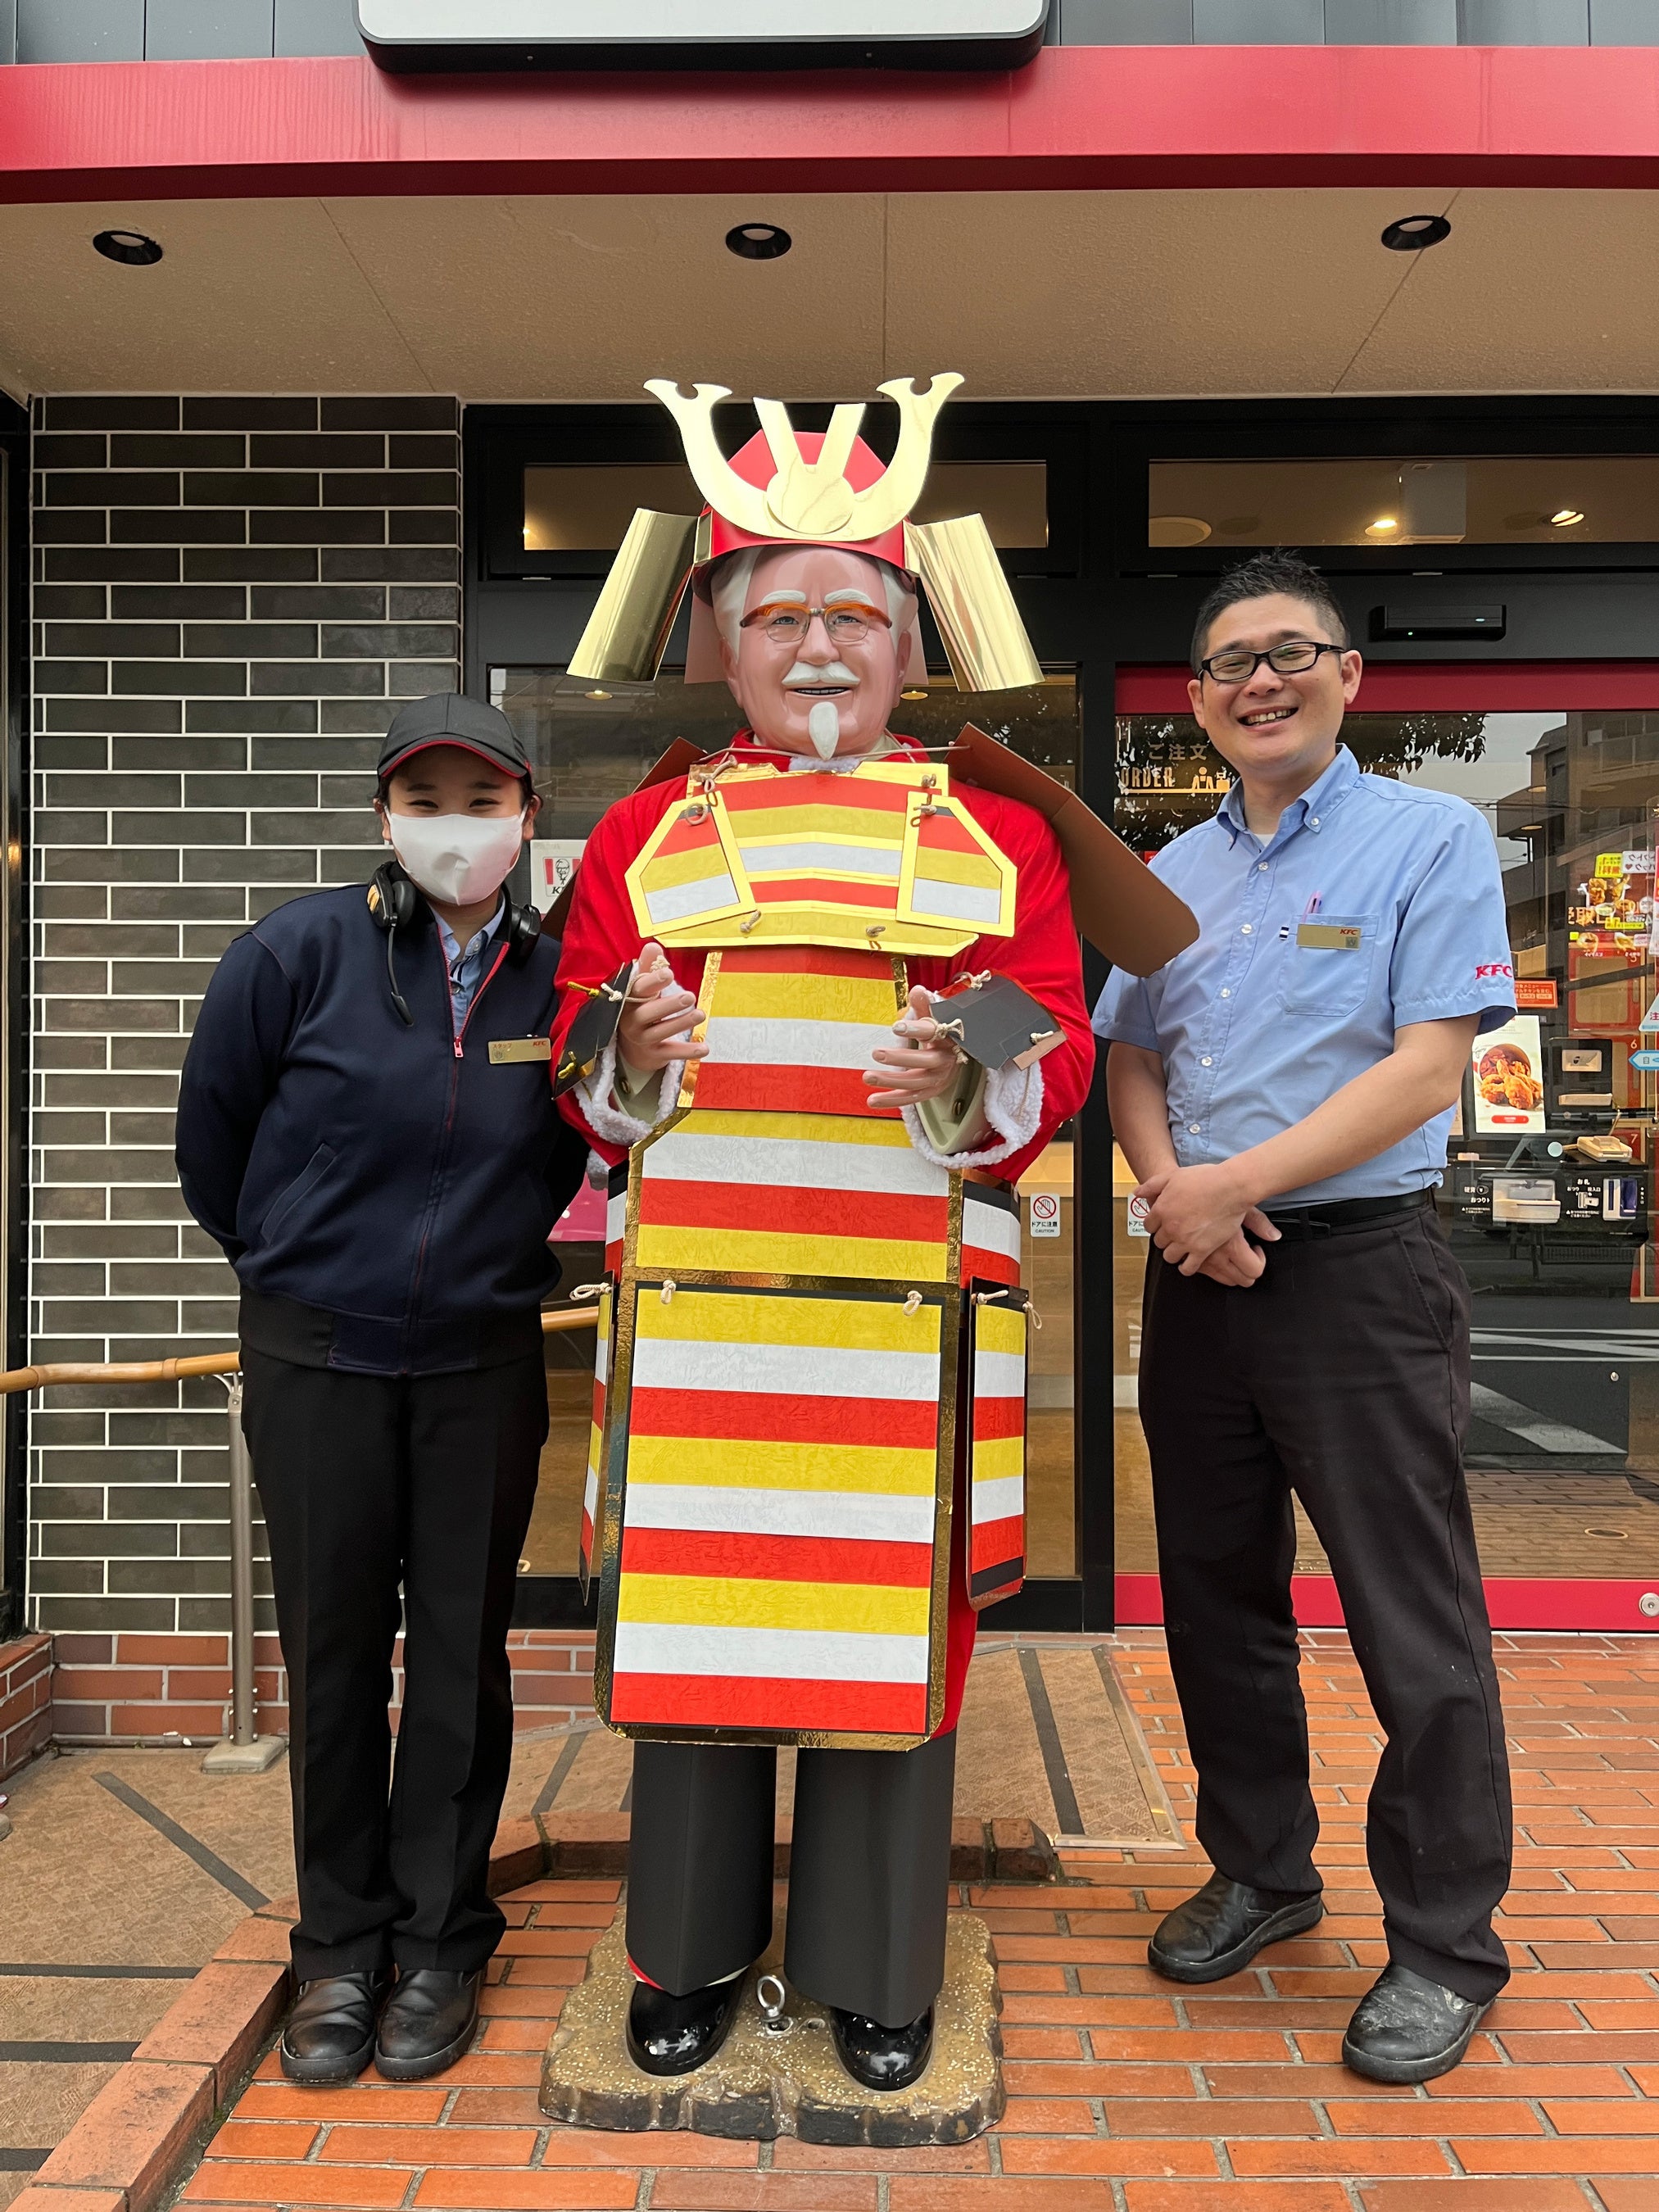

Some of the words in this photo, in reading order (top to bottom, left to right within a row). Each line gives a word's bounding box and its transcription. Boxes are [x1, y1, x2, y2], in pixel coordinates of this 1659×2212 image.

[1149, 743, 1208, 761] ご注文
[1120, 766, 1175, 787] ORDER
[1475, 964, 1513, 980] KFC
[1630, 1039, 1638, 1049] 6
[1630, 1133, 1639, 1145] 7
